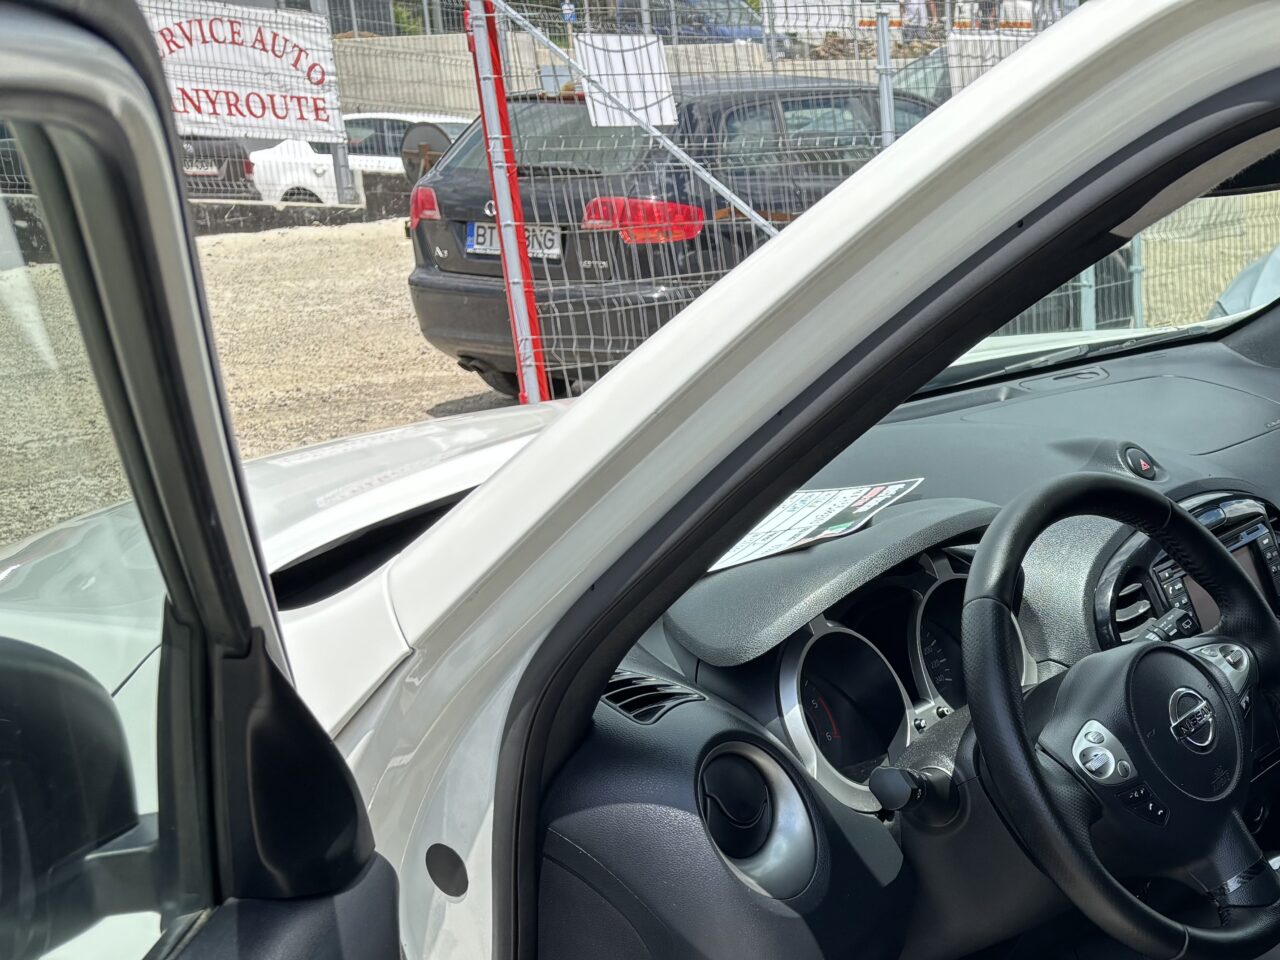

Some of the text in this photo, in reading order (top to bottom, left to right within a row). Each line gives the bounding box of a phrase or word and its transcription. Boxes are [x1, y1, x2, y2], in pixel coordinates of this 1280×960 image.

[158, 17, 327, 87] RVICE AUTO
[171, 86, 331, 124] NYROUTE
[475, 225, 495, 246] BT
[1179, 704, 1211, 734] NISSAN
